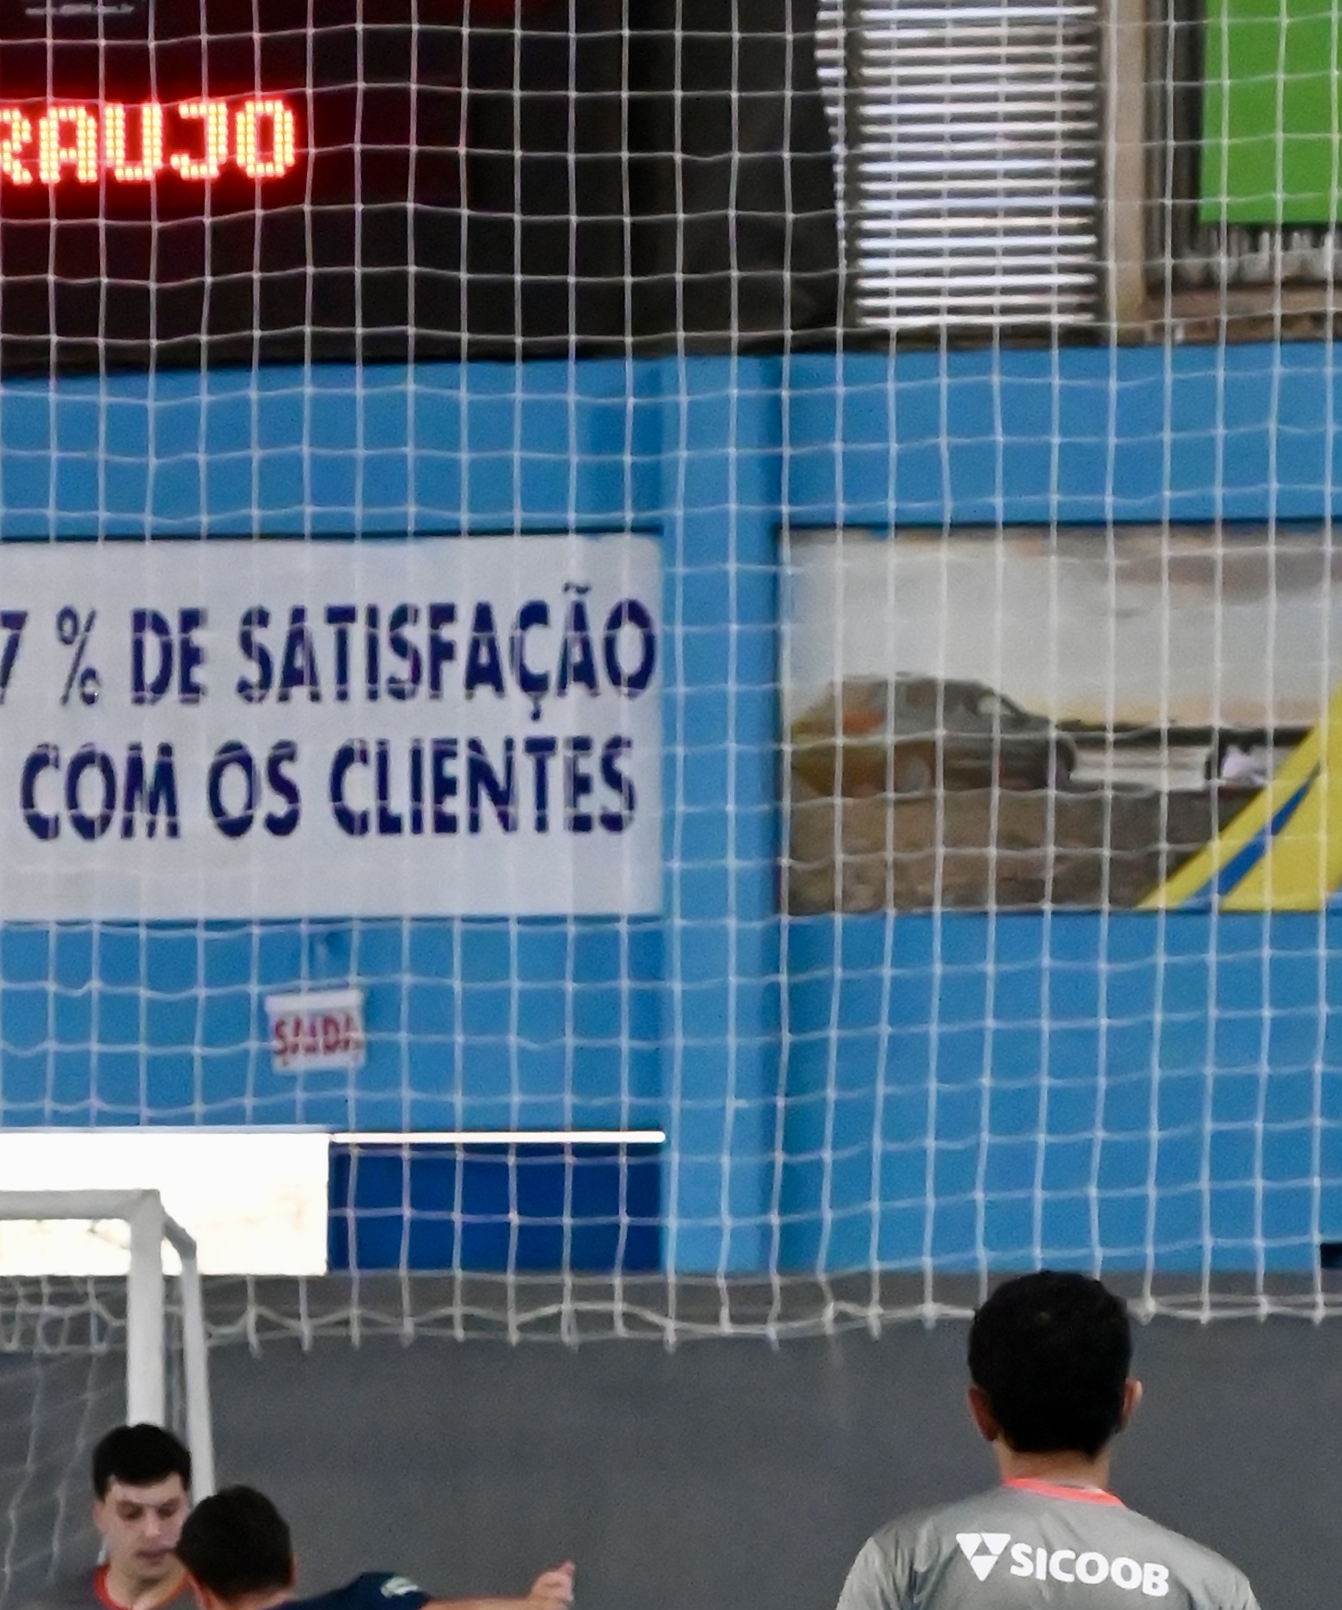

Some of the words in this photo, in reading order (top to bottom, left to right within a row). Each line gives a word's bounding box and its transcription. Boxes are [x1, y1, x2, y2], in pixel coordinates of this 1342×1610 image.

[55, 605, 101, 706] %
[130, 607, 208, 706] DE
[236, 581, 657, 721] SATISFAÇÃO
[20, 742, 181, 841] COM
[207, 740, 302, 839] OS
[329, 736, 638, 837] CLIENTES
[1010, 1543, 1170, 1597] SICOOB
